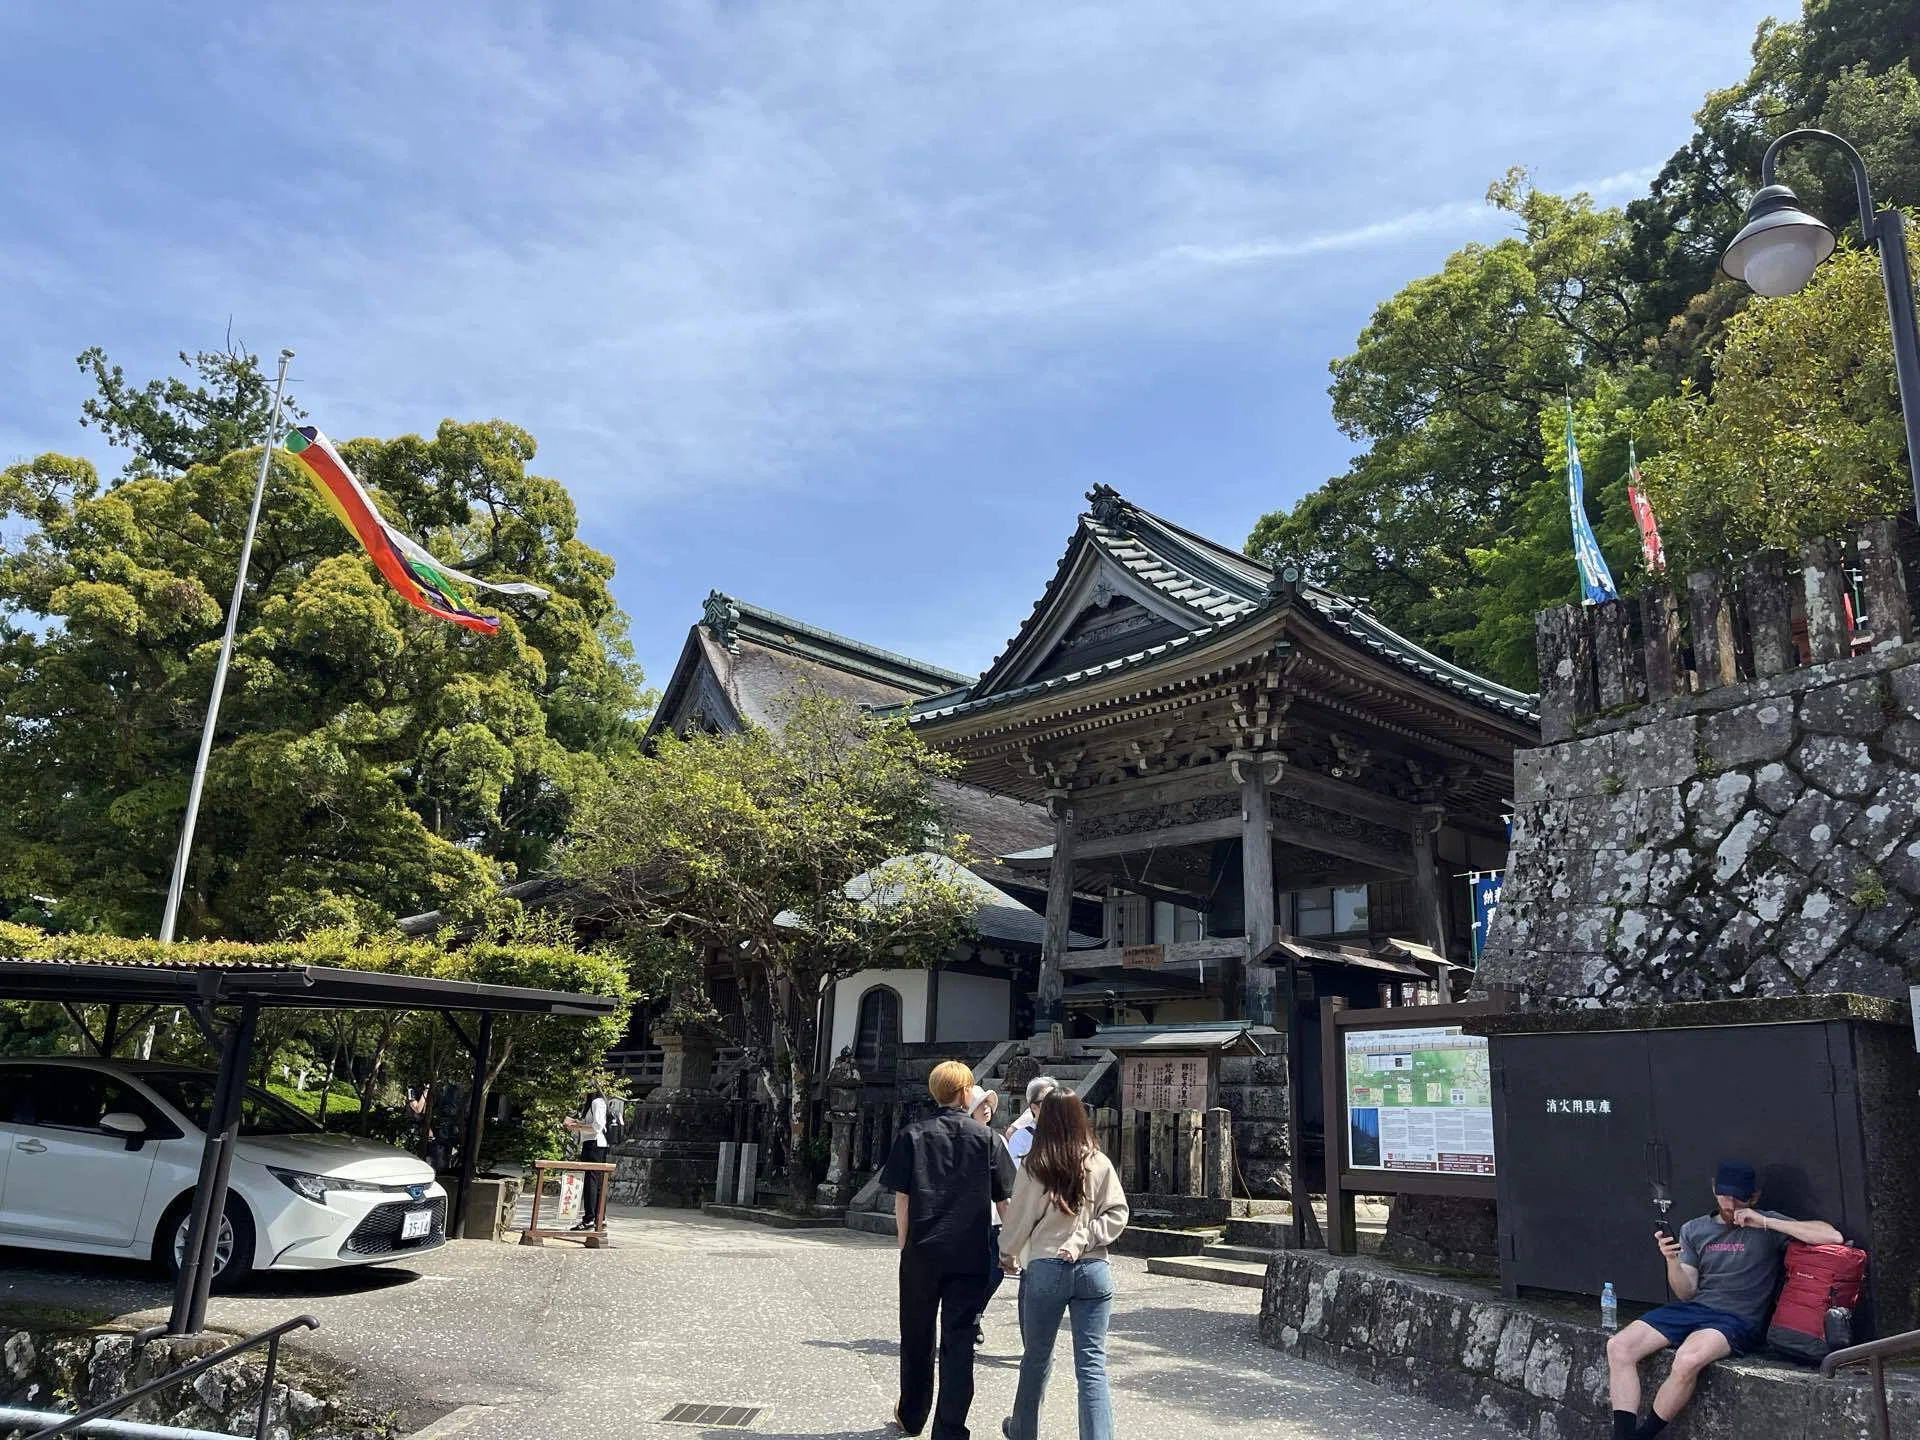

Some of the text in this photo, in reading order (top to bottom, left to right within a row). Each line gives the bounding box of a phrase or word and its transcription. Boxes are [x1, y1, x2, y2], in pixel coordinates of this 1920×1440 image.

[1546, 1099, 1611, 1114] 消火用具庫
